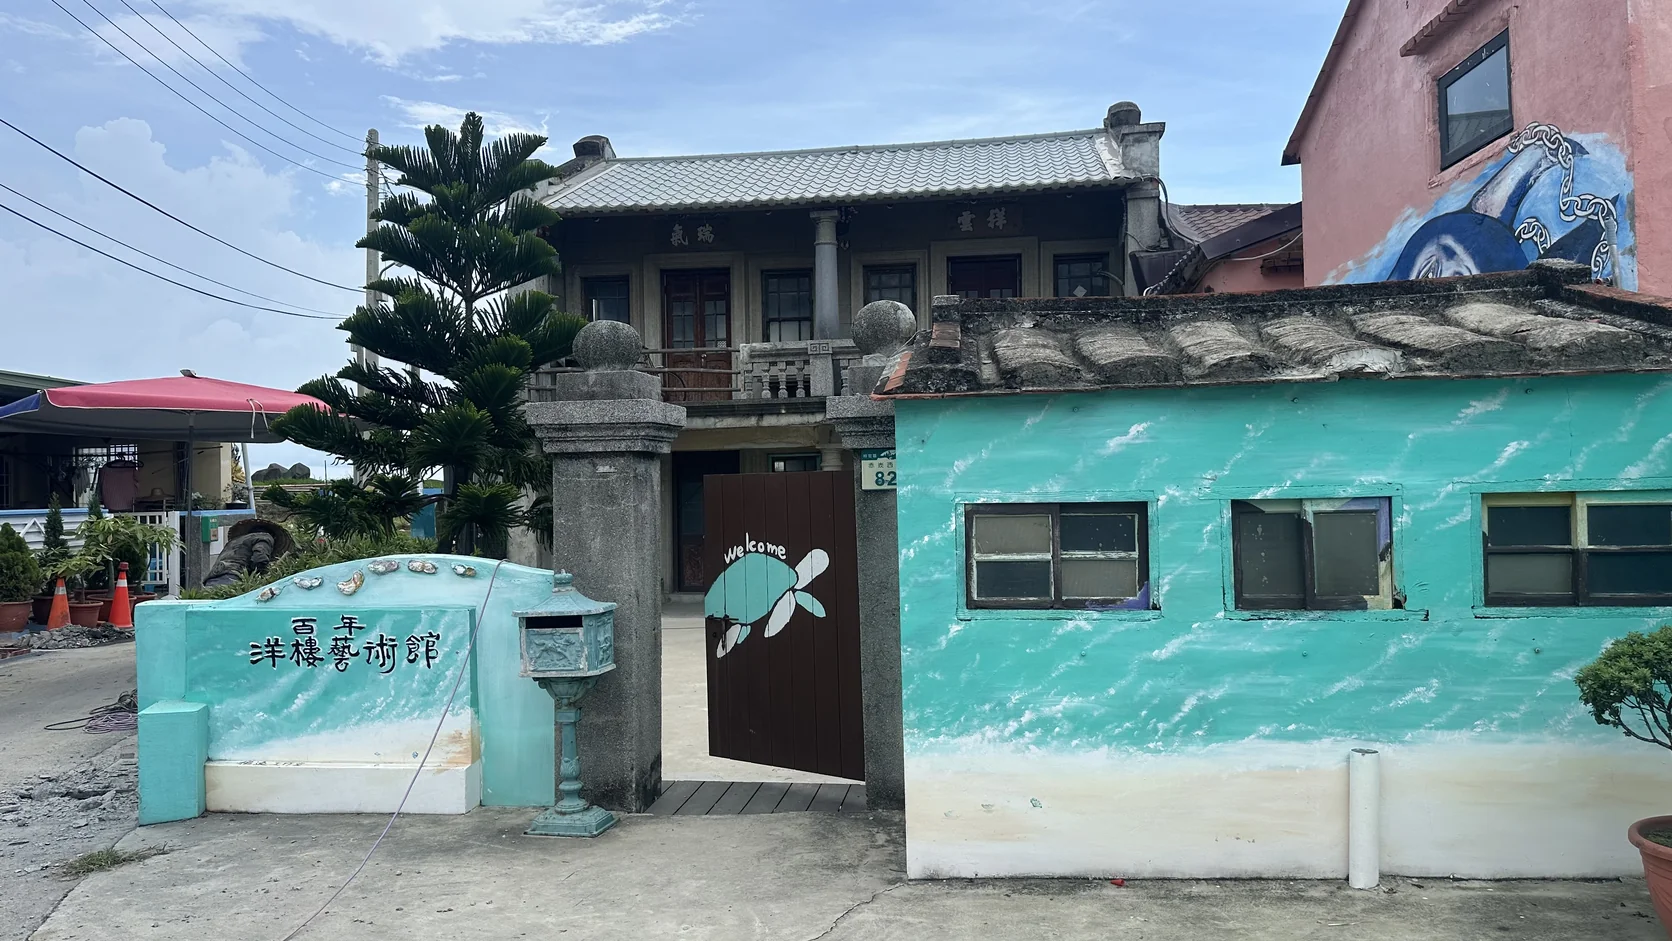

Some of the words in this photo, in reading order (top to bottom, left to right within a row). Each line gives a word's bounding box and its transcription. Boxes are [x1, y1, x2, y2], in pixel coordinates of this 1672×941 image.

[875, 471, 897, 486] 82
[724, 532, 787, 564] welcome
[291, 614, 367, 636] 百年
[250, 631, 441, 674] 洋樓藝術館
